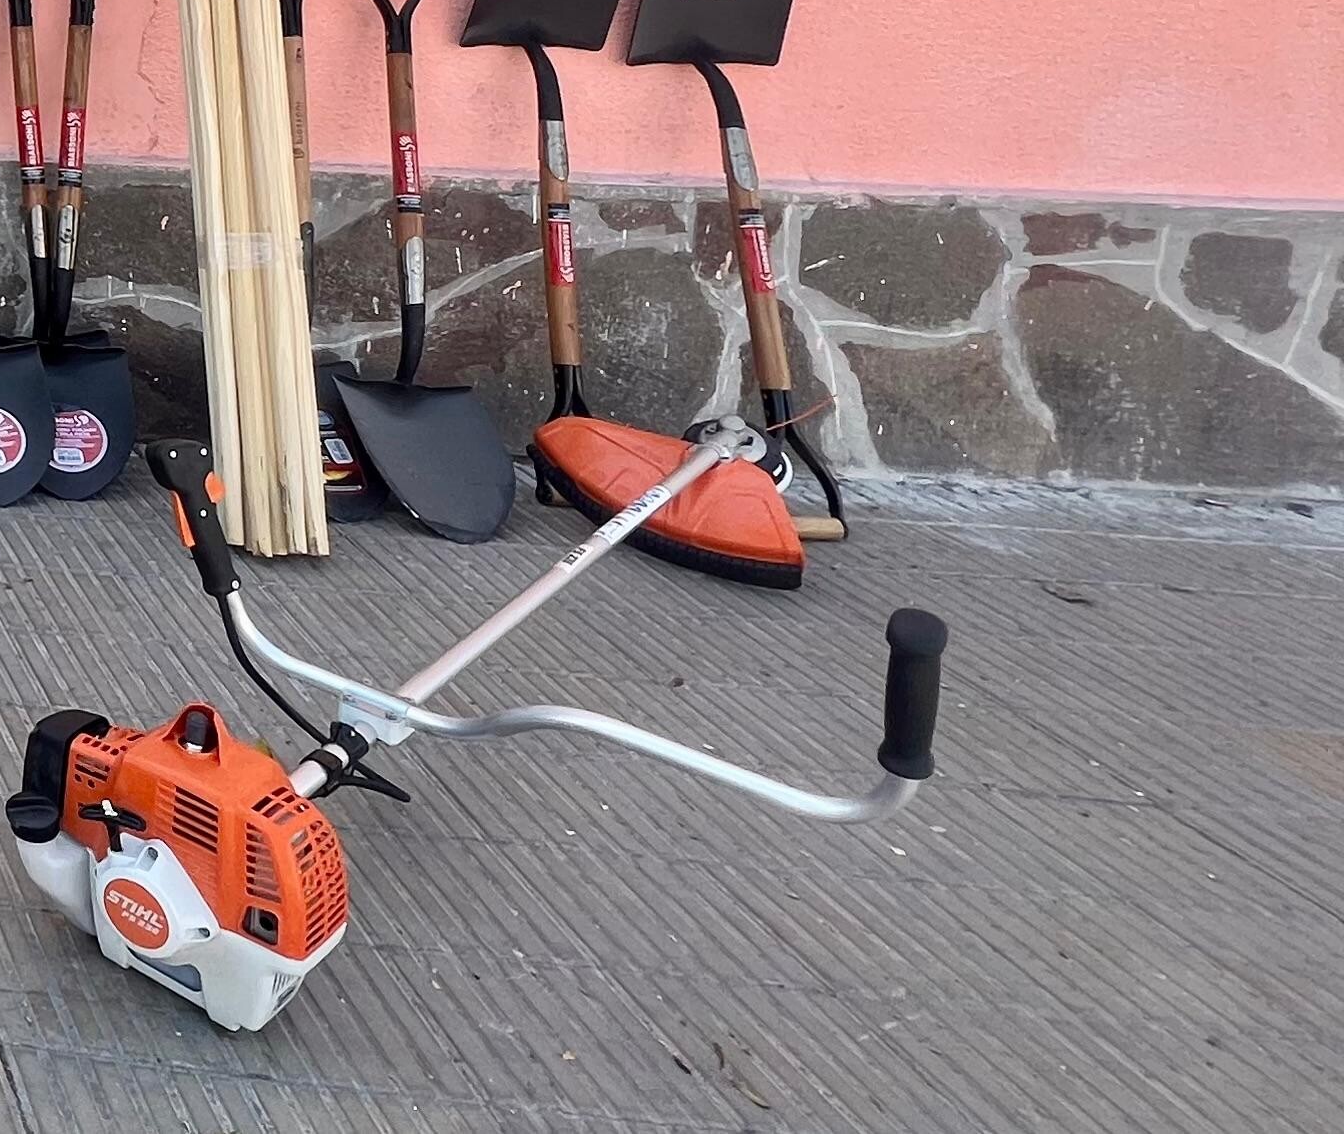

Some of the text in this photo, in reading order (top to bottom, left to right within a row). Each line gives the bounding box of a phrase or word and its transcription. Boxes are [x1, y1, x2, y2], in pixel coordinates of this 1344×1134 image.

[25, 124, 37, 165] BIASSONI
[67, 127, 77, 167] BIASSONI
[404, 151, 416, 193] BIASSONI
[562, 223, 572, 267] BIASSONI
[106, 889, 163, 929] STIHL
